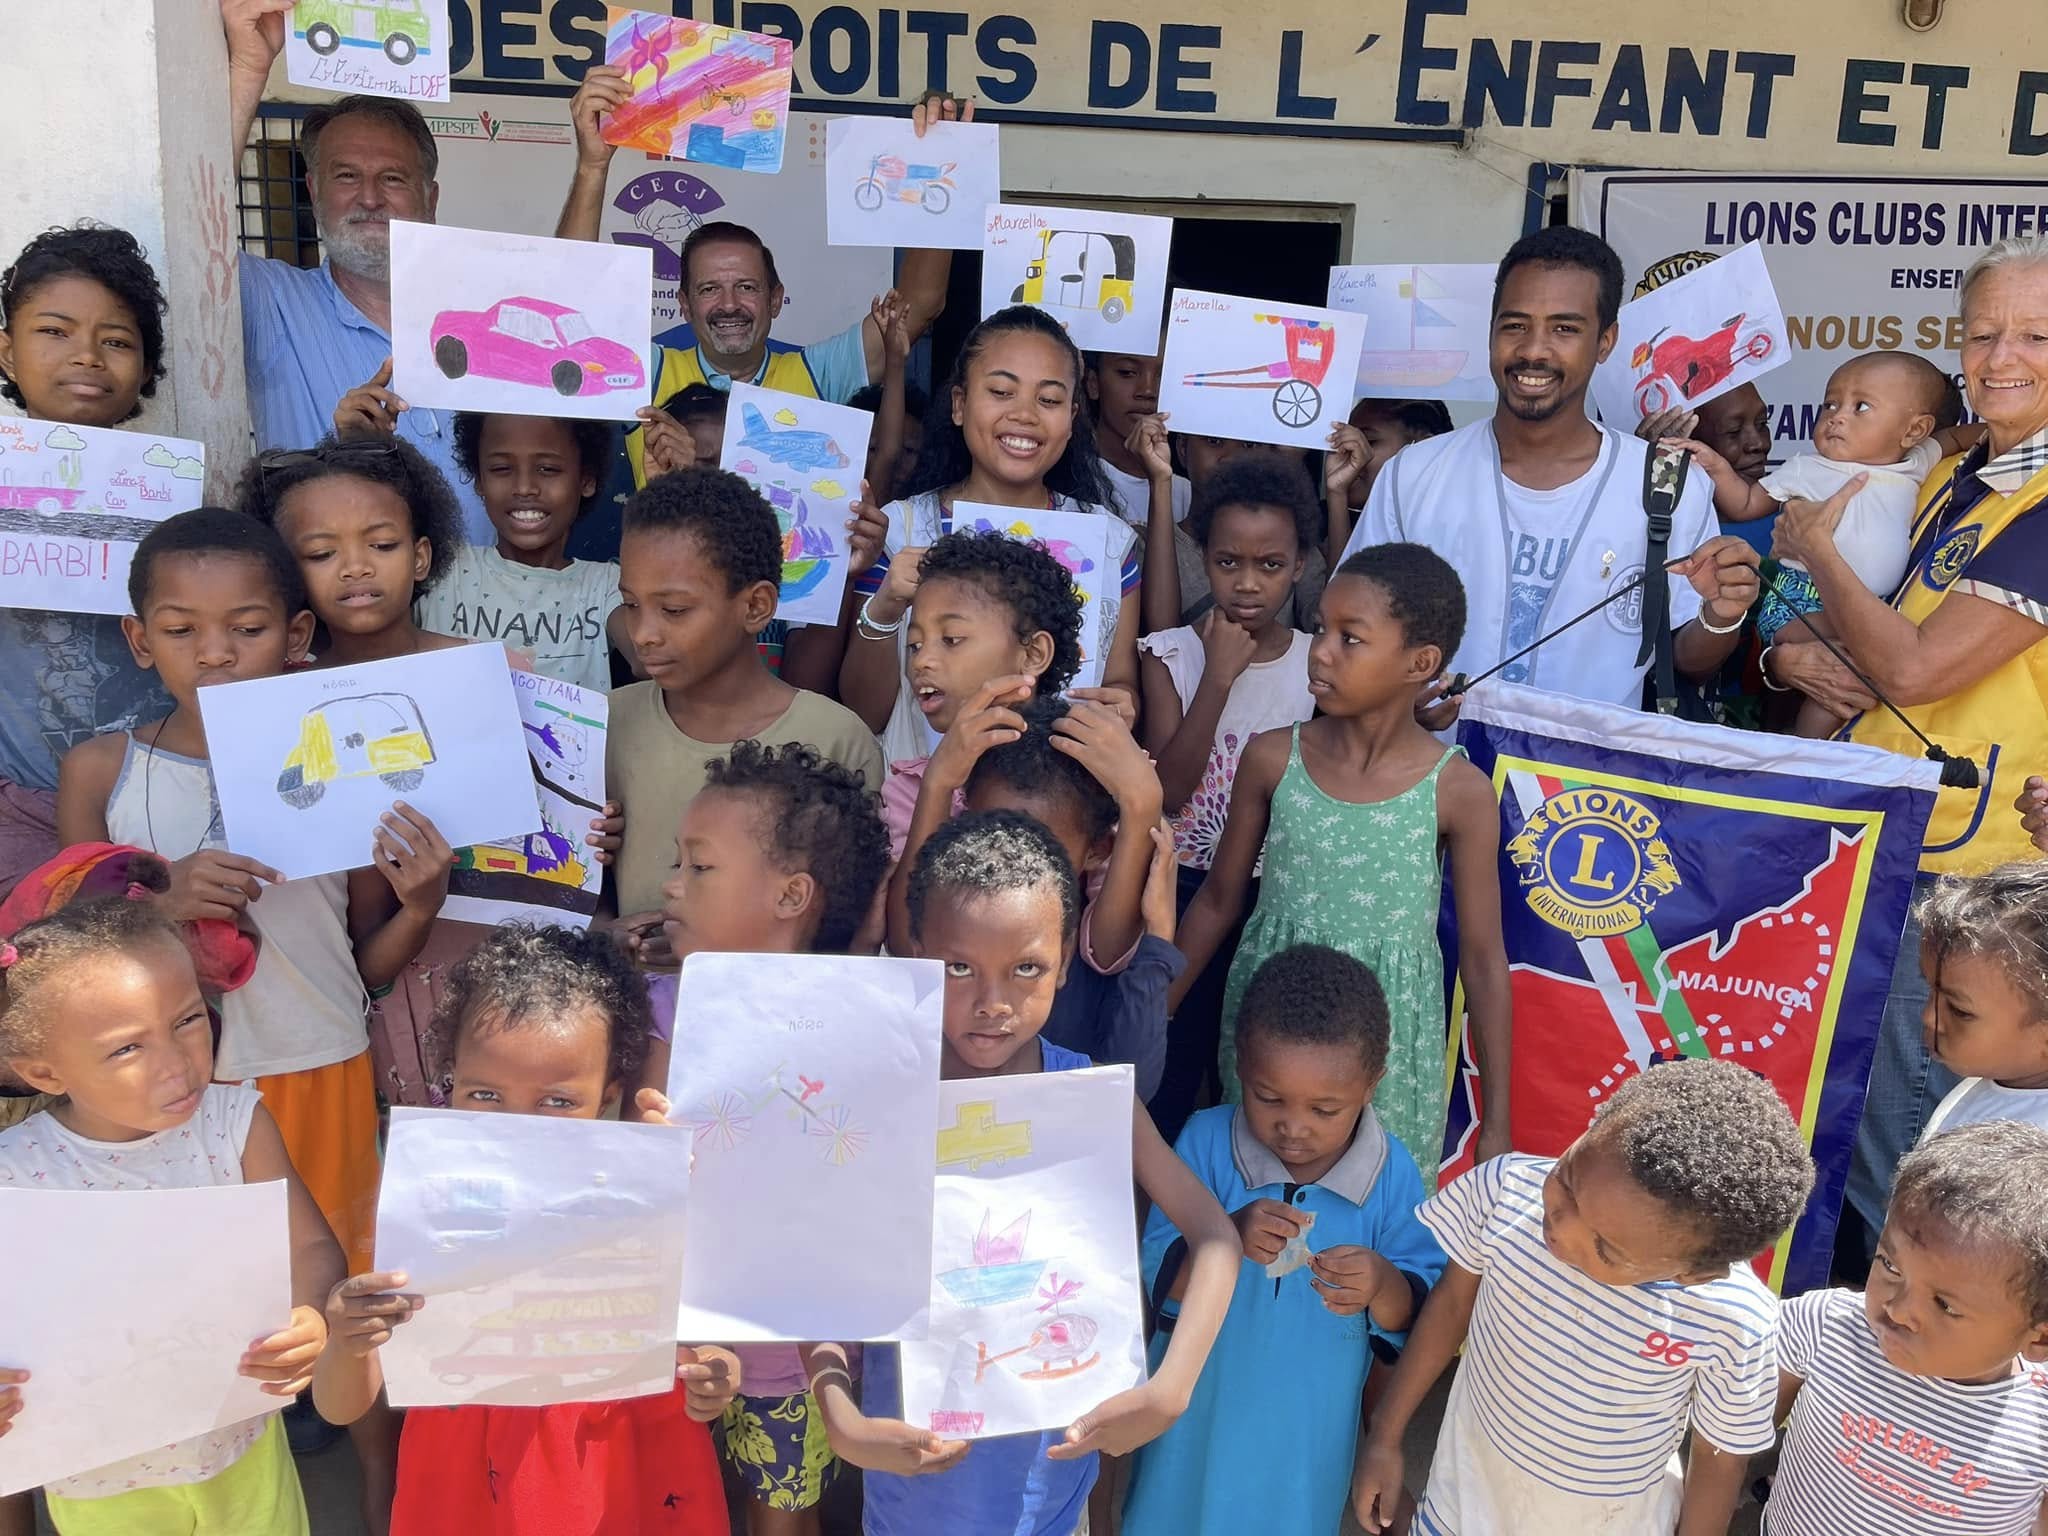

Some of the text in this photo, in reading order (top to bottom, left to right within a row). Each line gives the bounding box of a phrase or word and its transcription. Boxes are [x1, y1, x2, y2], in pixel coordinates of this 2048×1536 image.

[670, 0, 1037, 106] ROITS
[1087, 20, 1222, 113] DE
[1836, 58, 1971, 151] ET
[629, 176, 708, 201] CECJ
[1704, 201, 1817, 246] LIONS
[1828, 202, 1946, 246] CLUBS
[1654, 258, 1712, 285] LIO
[1787, 316, 1902, 350] NOUS
[450, 601, 601, 645] ANANAS
[1554, 793, 1653, 834] LIONS
[1570, 833, 1616, 890] L
[1534, 892, 1633, 930] INTERNATIONAL
[1676, 970, 1813, 1012] MAJUNGA
[1639, 1331, 1695, 1366] 96
